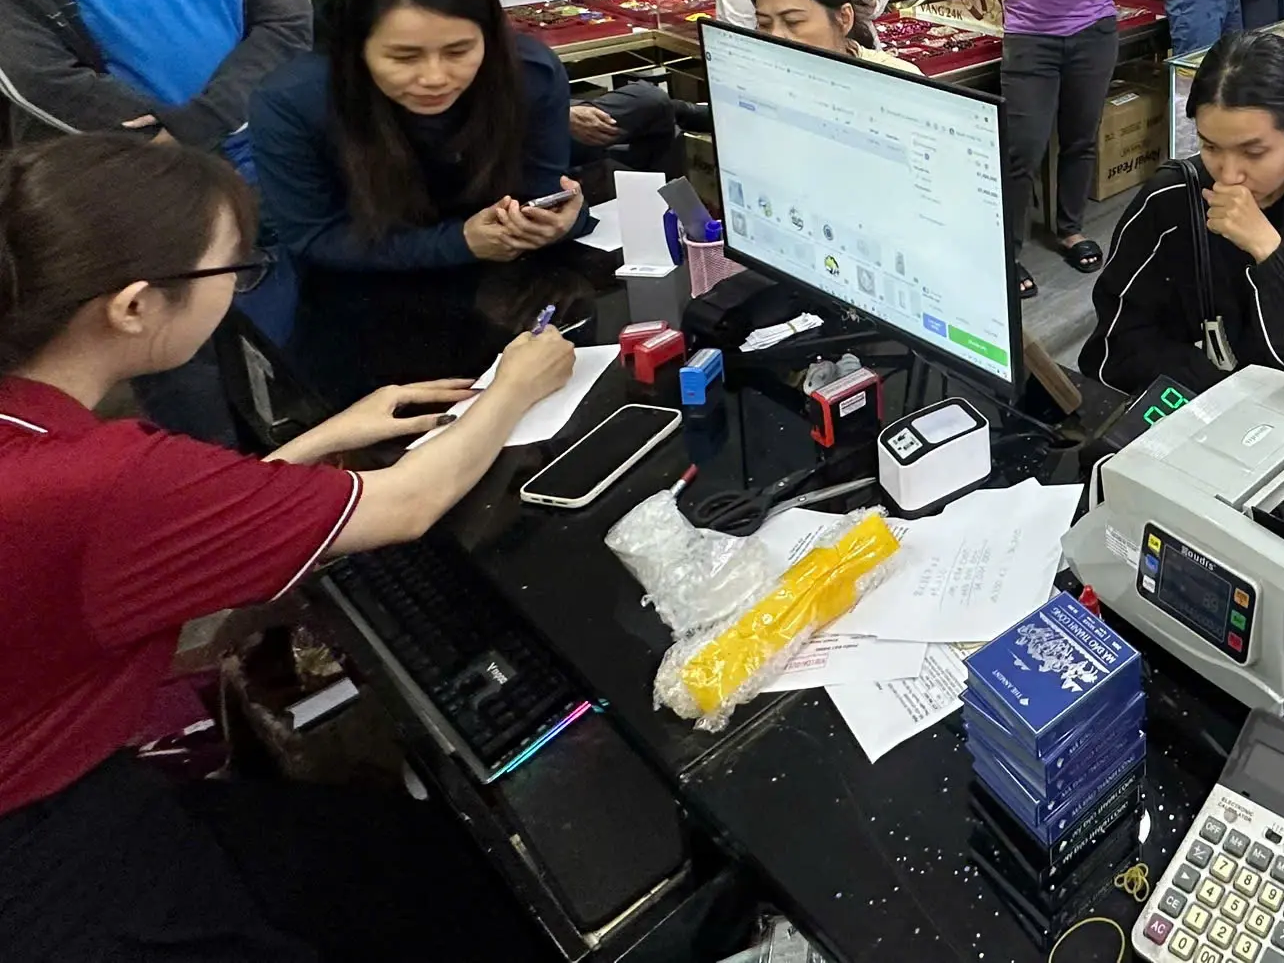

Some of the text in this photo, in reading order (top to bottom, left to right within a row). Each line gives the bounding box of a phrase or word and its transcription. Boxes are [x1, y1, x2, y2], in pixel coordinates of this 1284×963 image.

[1107, 157, 1134, 179] Feast
[1051, 607, 1072, 626] CÔNG
[1221, 797, 1254, 817] ELECTRONIC
[1205, 822, 1220, 834] OFF
[1231, 836, 1243, 847] M+
[1220, 861, 1229, 871] 7
[1243, 875, 1252, 885] 8
[1206, 886, 1214, 897] 4
[1268, 889, 1277, 900] 9
[1165, 894, 1179, 909] CE
[1230, 900, 1239, 911] 5
[1194, 912, 1201, 923] 1
[1255, 915, 1264, 926] 6
[1151, 920, 1166, 935] AC
[1218, 926, 1227, 939] 2
[1178, 938, 1187, 950] 0
[1242, 941, 1251, 952] 3
